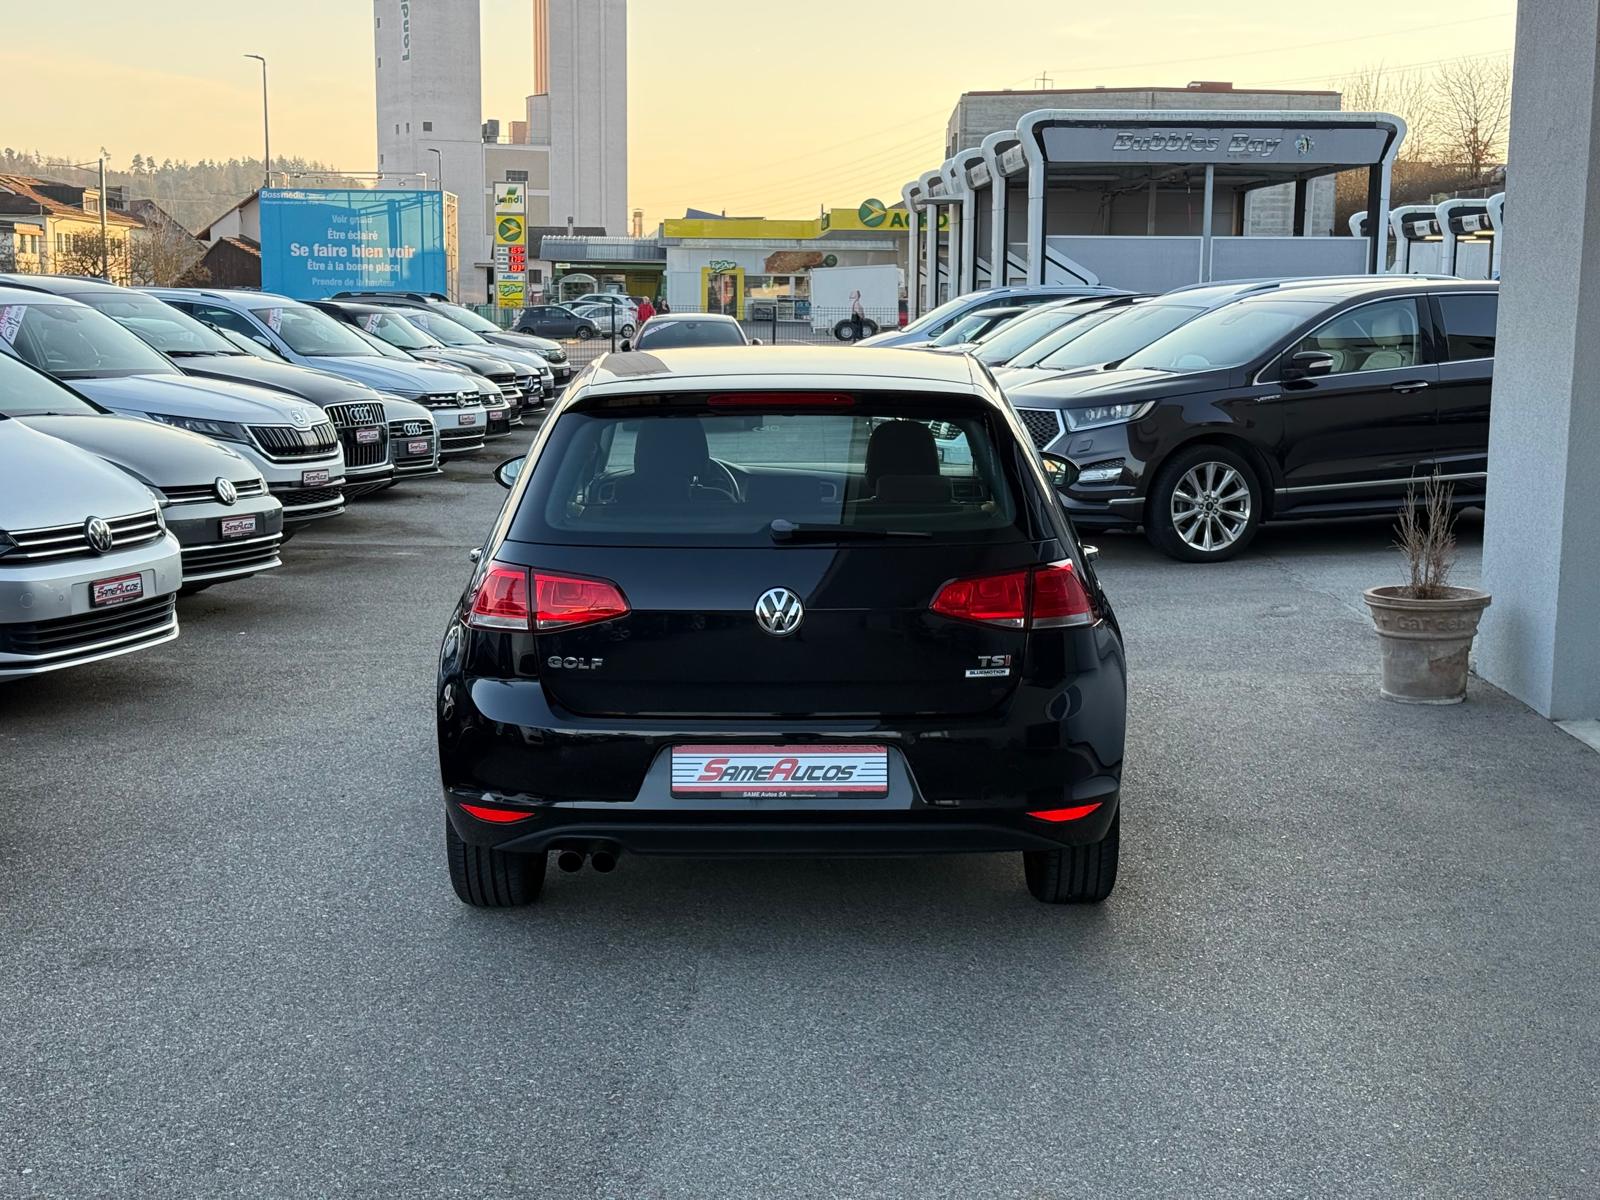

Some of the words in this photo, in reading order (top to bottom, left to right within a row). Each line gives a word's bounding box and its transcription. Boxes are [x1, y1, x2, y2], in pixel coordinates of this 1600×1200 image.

[400, 0, 410, 61] Land
[1113, 132, 1220, 151] Bubbles
[1228, 133, 1283, 157] Bay
[332, 215, 347, 223] Voir
[328, 227, 345, 239] Être
[348, 230, 378, 240] éclairé
[290, 243, 309, 256] Se
[313, 243, 347, 257] faire
[352, 244, 383, 258] bien
[387, 245, 415, 258] voir
[307, 259, 325, 270] Être
[327, 260, 333, 271] à
[336, 261, 344, 271] la
[346, 261, 373, 271] bonne
[376, 262, 400, 273] place
[312, 277, 342, 286] Prendre
[344, 277, 353, 286] de
[547, 656, 603, 669] GOLF
[978, 655, 1011, 667] TSI
